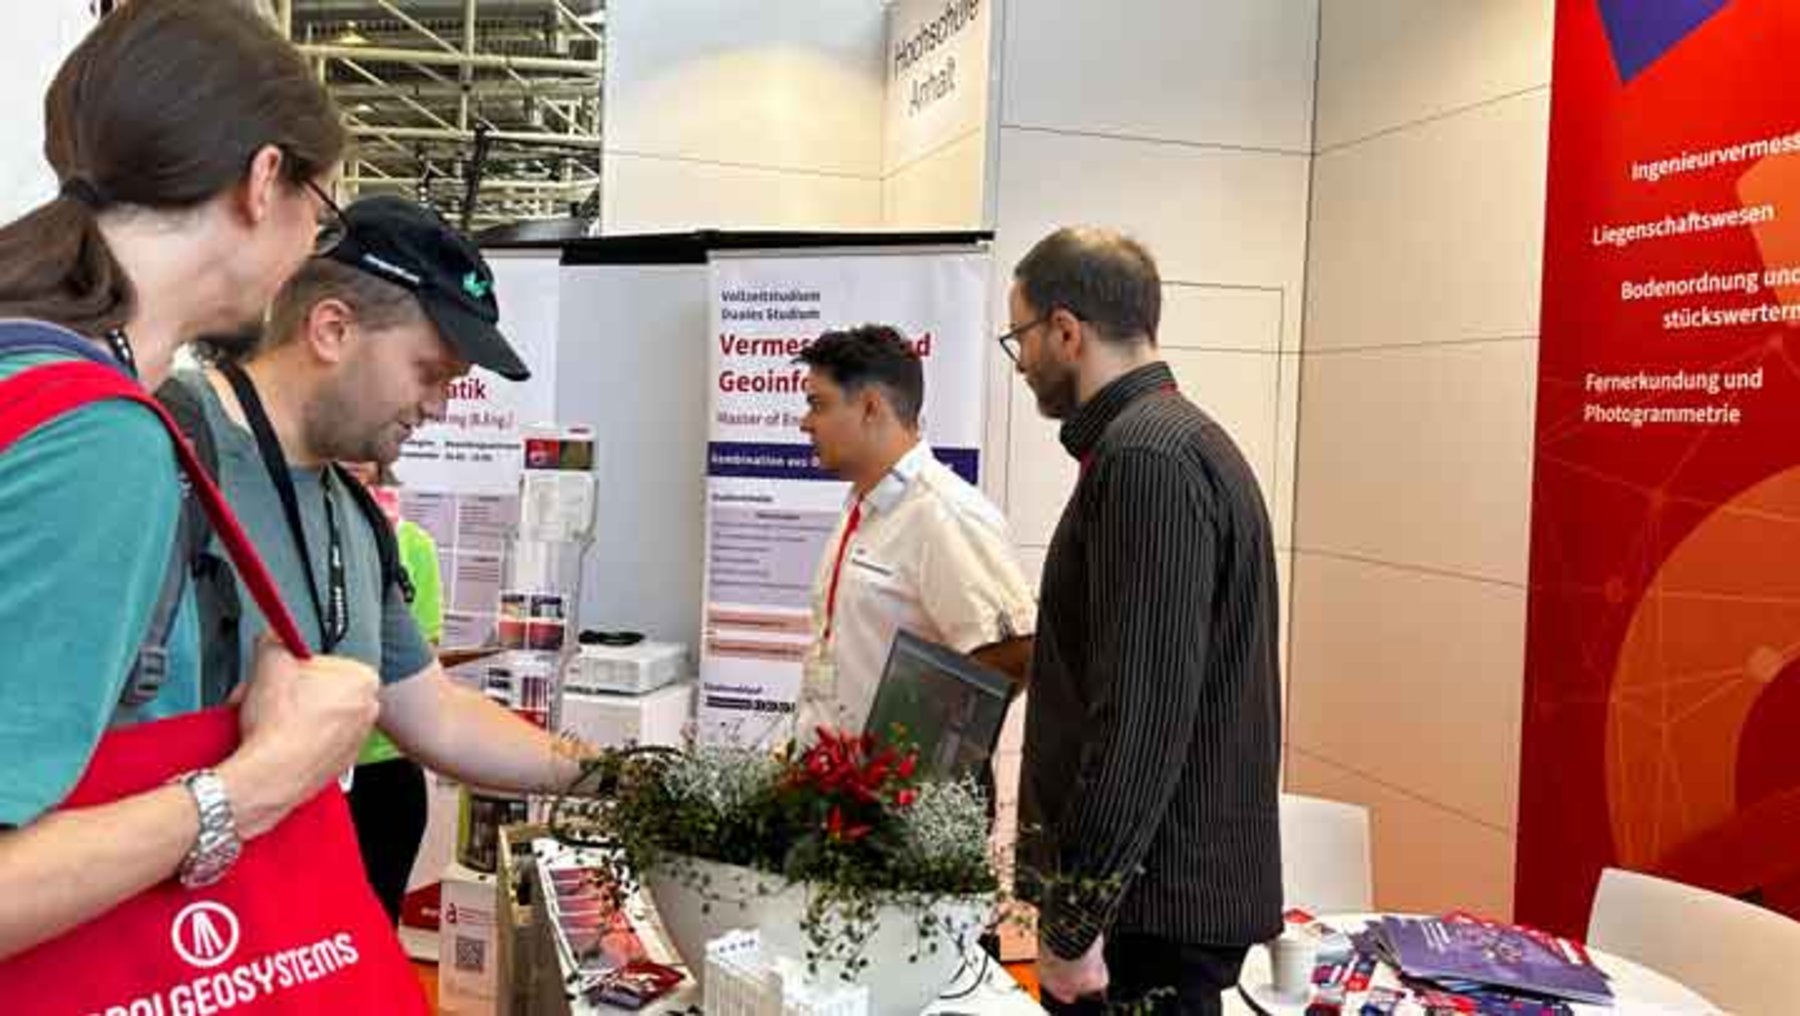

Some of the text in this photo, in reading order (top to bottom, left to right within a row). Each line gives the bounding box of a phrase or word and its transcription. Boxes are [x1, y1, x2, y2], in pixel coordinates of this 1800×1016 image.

[893, 0, 978, 80] Hochschule
[908, 56, 955, 117] Anhalt
[1592, 203, 1774, 246] Liegenschaftswesen
[1621, 271, 1759, 300] Bodenordnung
[766, 309, 820, 320] Studium
[1585, 368, 1764, 394] Fernerkundung und
[1583, 404, 1741, 428] Photogrammetrie
